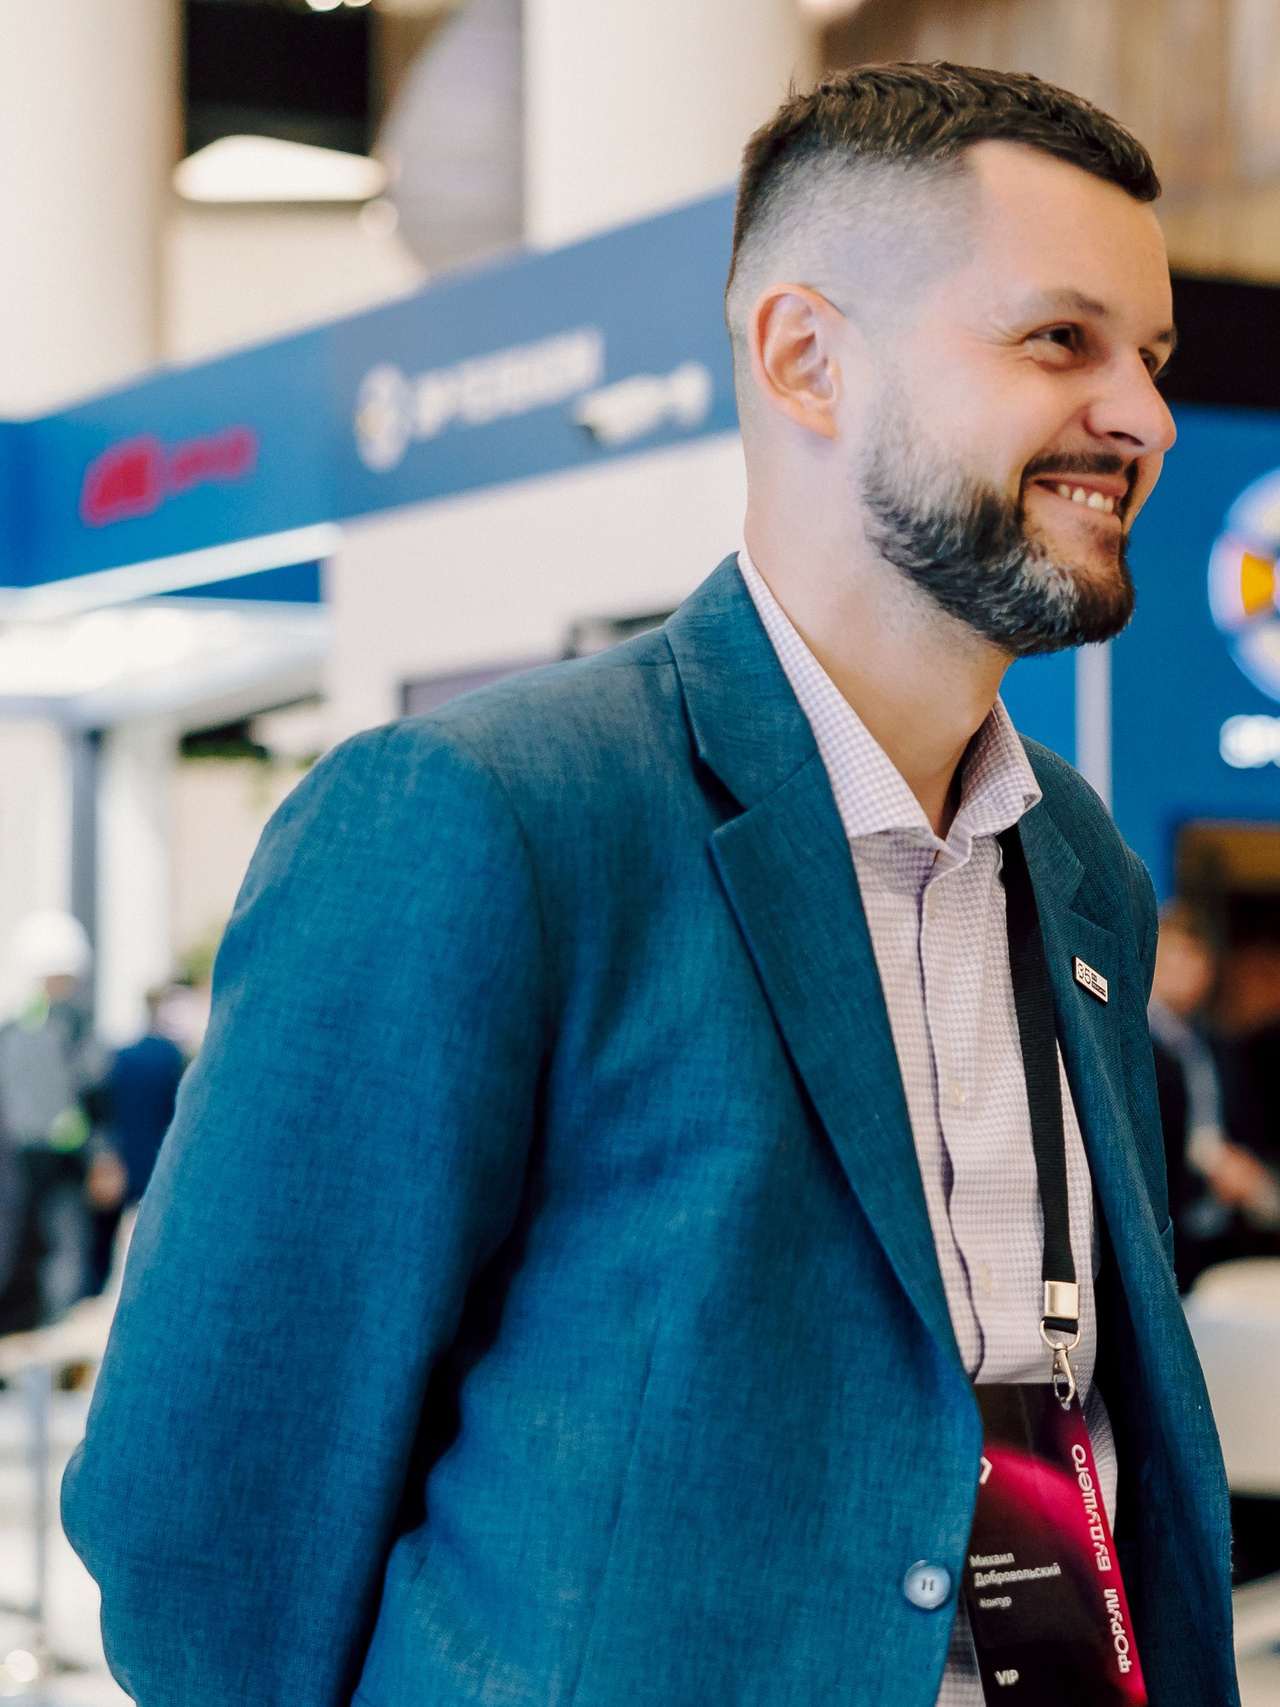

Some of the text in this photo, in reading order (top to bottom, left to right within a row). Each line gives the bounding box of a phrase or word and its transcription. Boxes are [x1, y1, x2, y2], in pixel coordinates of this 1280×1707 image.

[970, 1552, 1015, 1567] Михаил
[973, 1562, 1062, 1588] Добровольский
[979, 1596, 1012, 1609] Контур
[1103, 1588, 1132, 1673] ФОРУМ
[994, 1669, 1019, 1686] VIP
